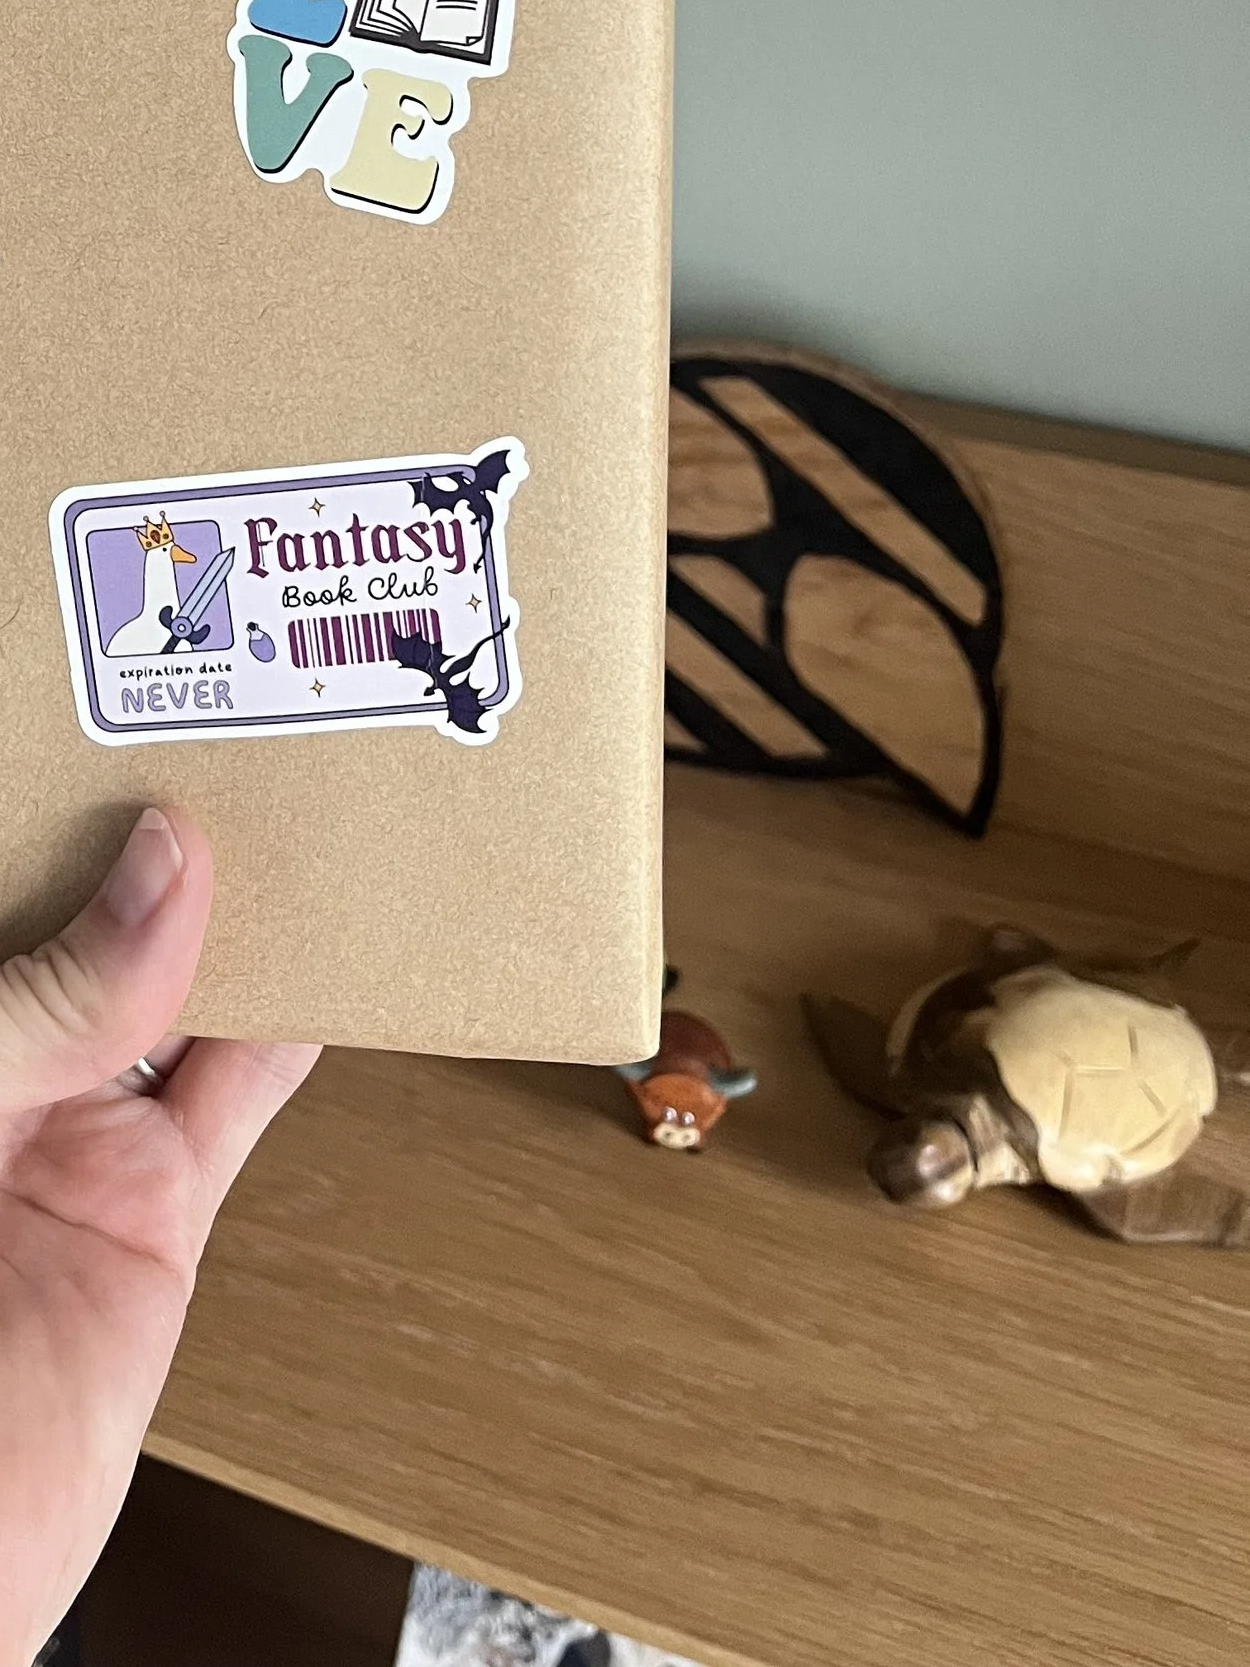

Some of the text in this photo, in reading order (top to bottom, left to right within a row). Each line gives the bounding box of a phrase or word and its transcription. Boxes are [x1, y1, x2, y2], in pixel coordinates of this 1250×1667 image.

[244, 512, 466, 579] Fantasy
[282, 566, 438, 608] Book Club
[119, 661, 233, 681] expiration date
[122, 679, 234, 714] NEVER
